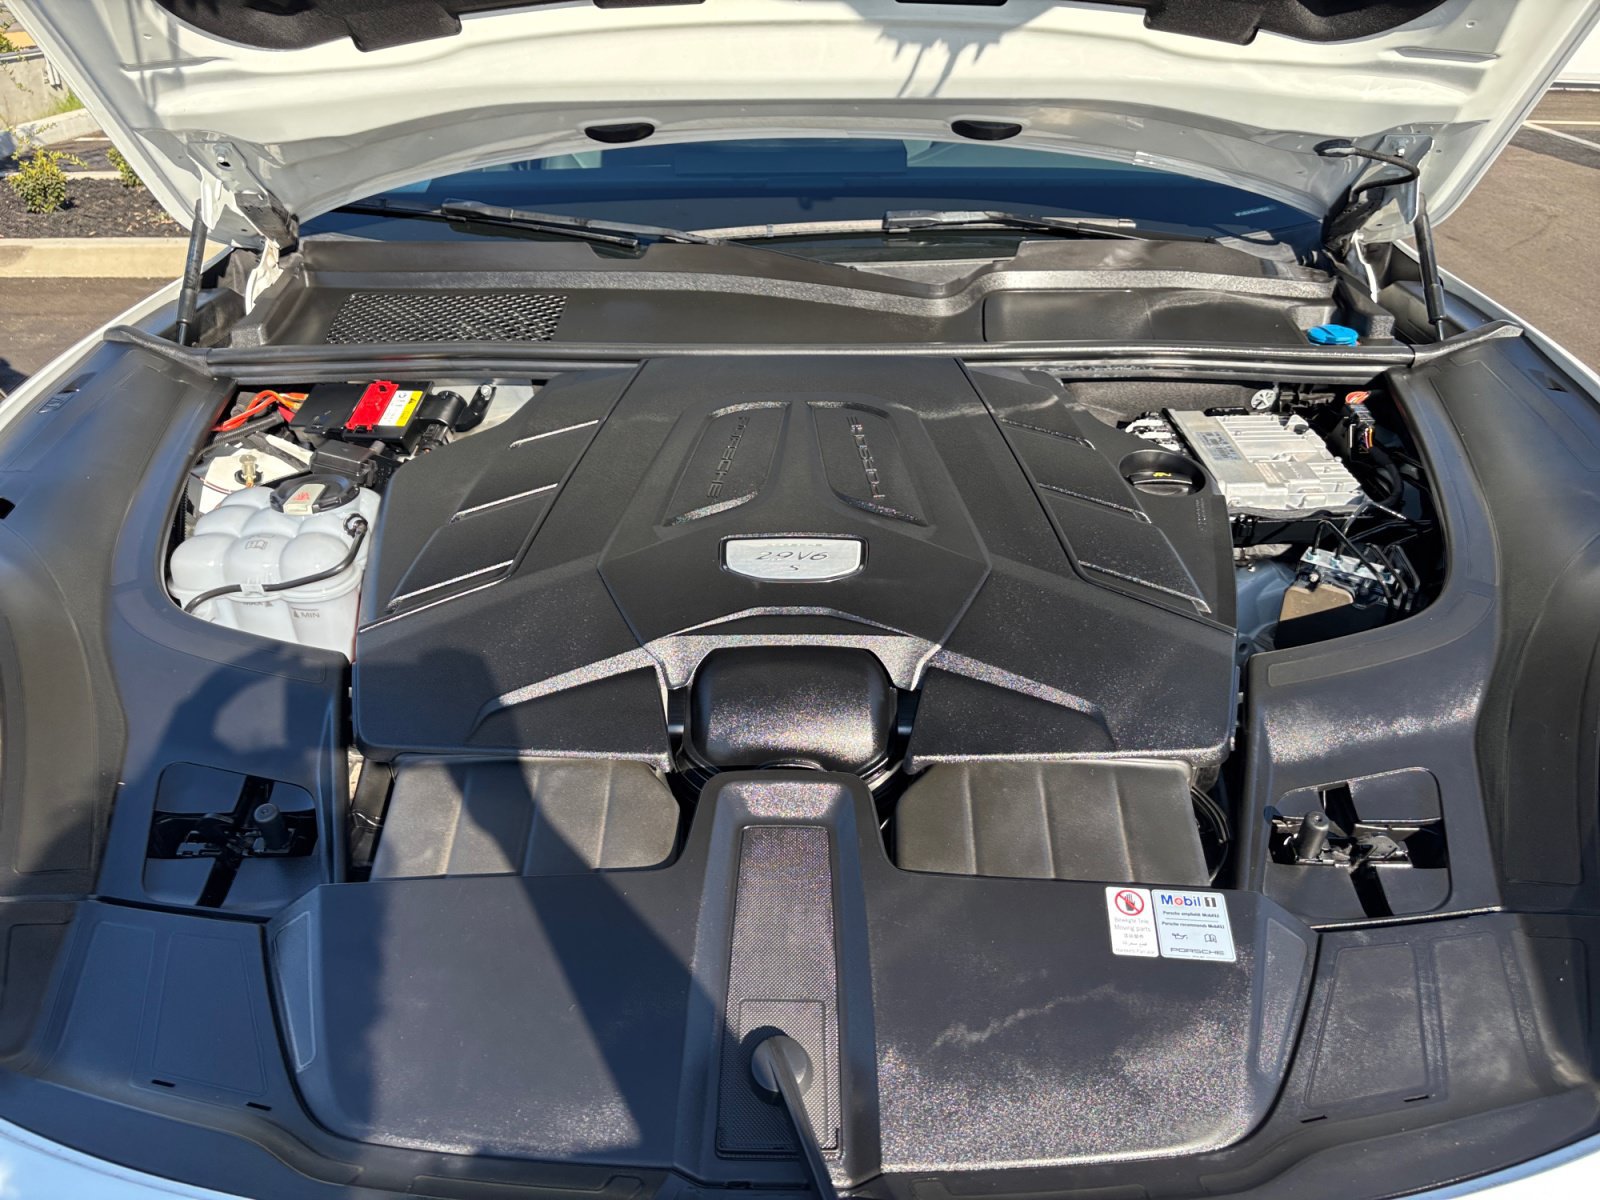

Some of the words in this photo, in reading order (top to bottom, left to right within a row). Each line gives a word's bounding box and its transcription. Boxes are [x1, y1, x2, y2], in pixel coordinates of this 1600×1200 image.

[1161, 894, 1201, 907] Mobil
[1205, 897, 1217, 907] 1
[1170, 947, 1224, 956] PORSCHE
